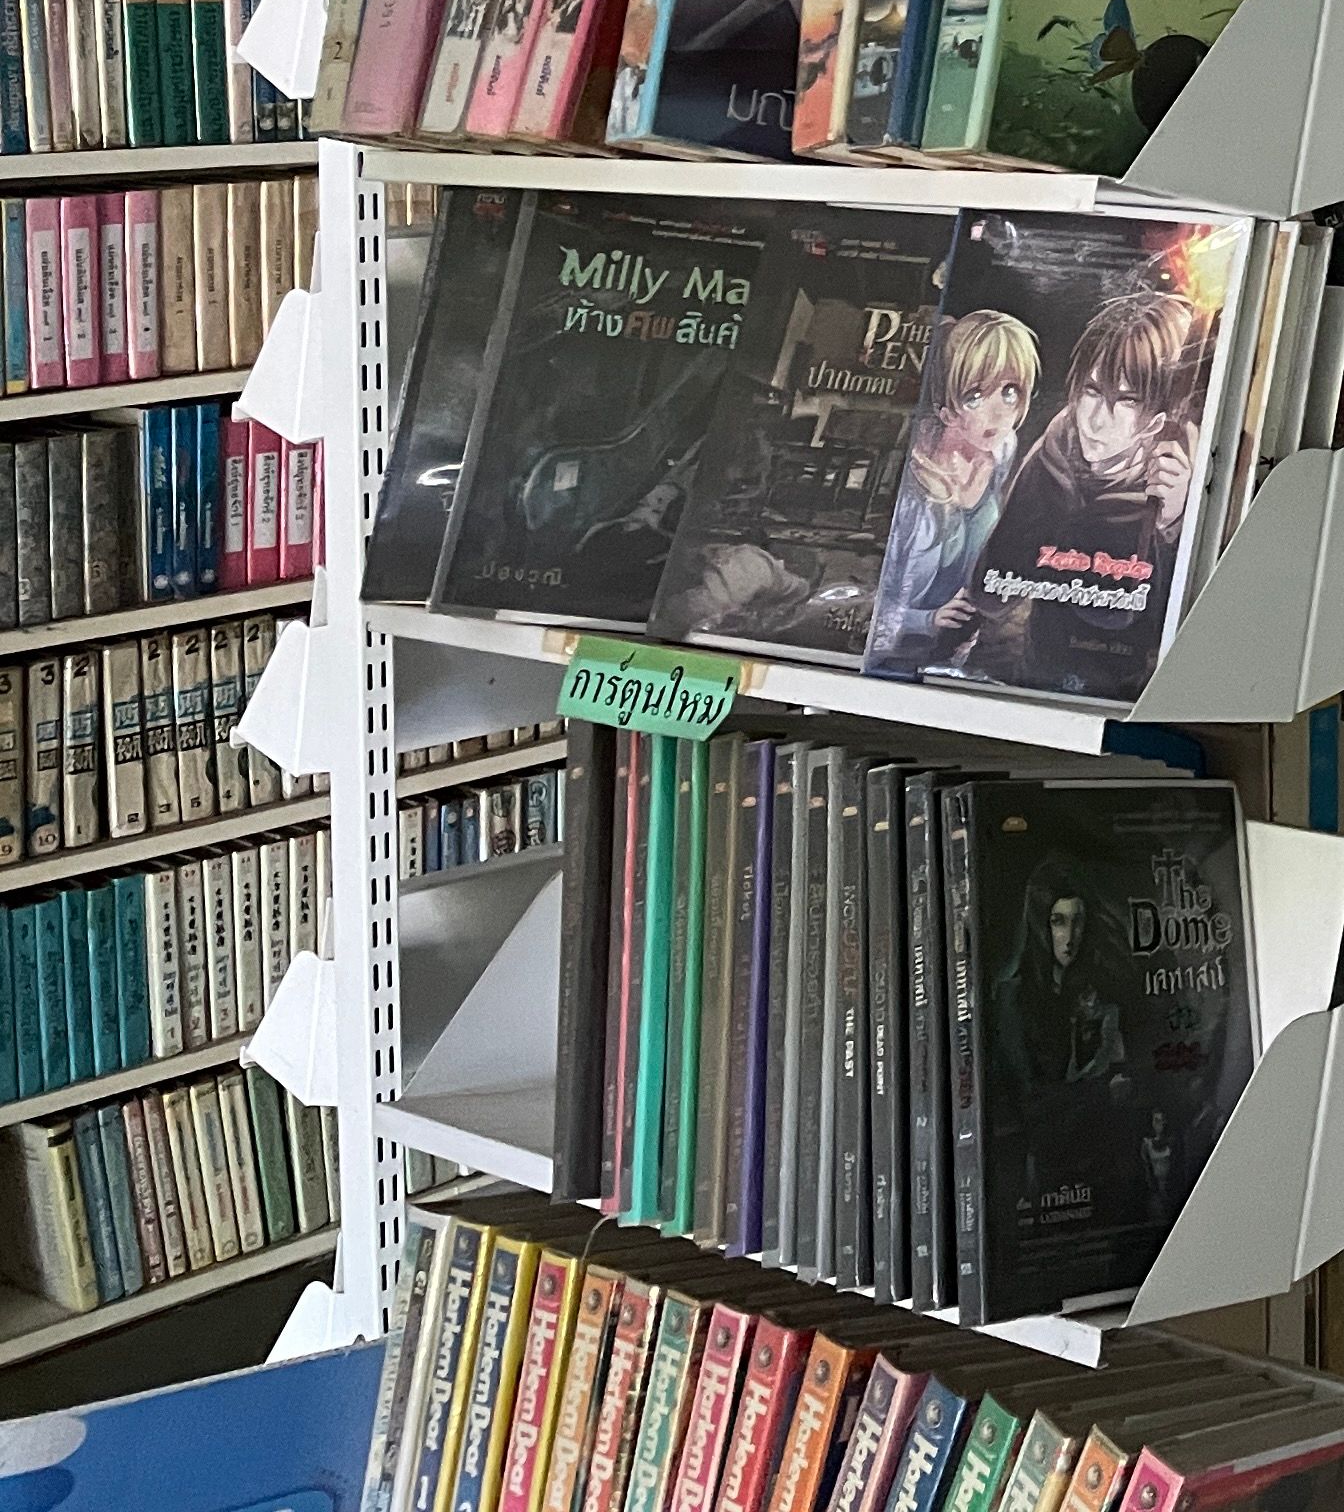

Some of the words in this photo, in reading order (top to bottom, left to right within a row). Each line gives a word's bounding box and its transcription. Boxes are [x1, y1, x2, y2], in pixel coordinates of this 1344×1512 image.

[727, 84, 795, 132] มณ
[558, 245, 669, 305] Milly
[568, 652, 736, 726] การ์ตูนใหม่
[1152, 848, 1212, 915] The
[1127, 896, 1233, 957] Dome
[436, 1267, 472, 1379] Harlem
[469, 1293, 510, 1402] Harlem
[517, 1309, 557, 1420] Harlem
[557, 1325, 600, 1434] Harlem
